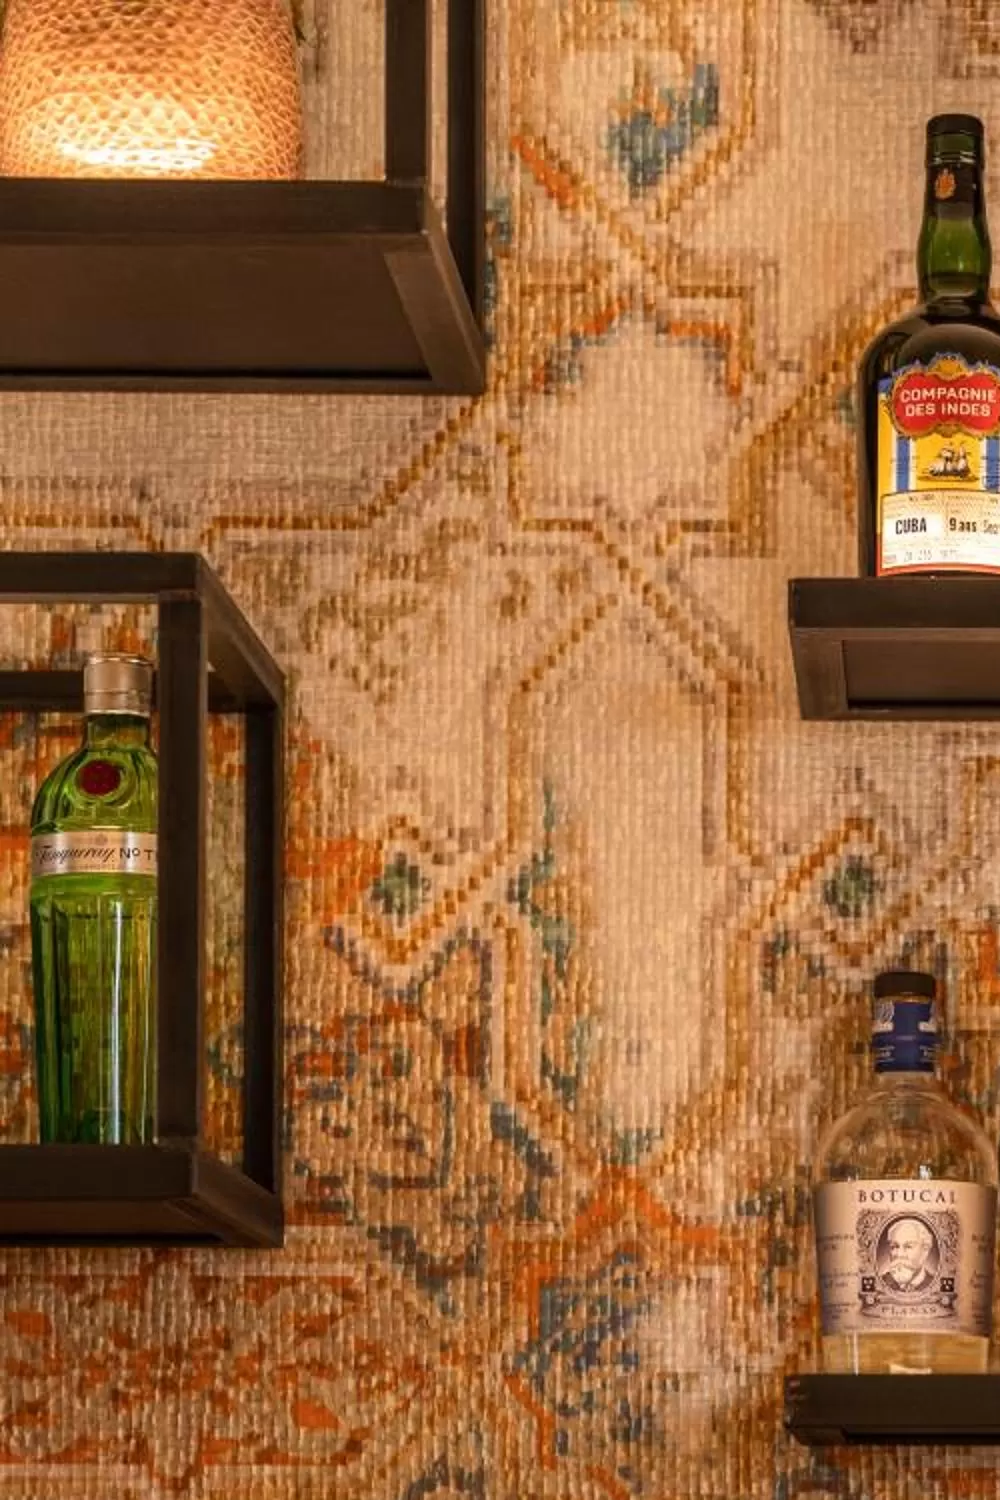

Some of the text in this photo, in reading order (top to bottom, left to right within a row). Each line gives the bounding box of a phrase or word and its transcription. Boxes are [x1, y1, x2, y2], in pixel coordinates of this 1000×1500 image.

[901, 387, 997, 404] COMPAGNIE
[905, 402, 991, 417] DES INDES
[895, 518, 928, 535] CUBA
[857, 1188, 956, 1204] BOTUCAL
